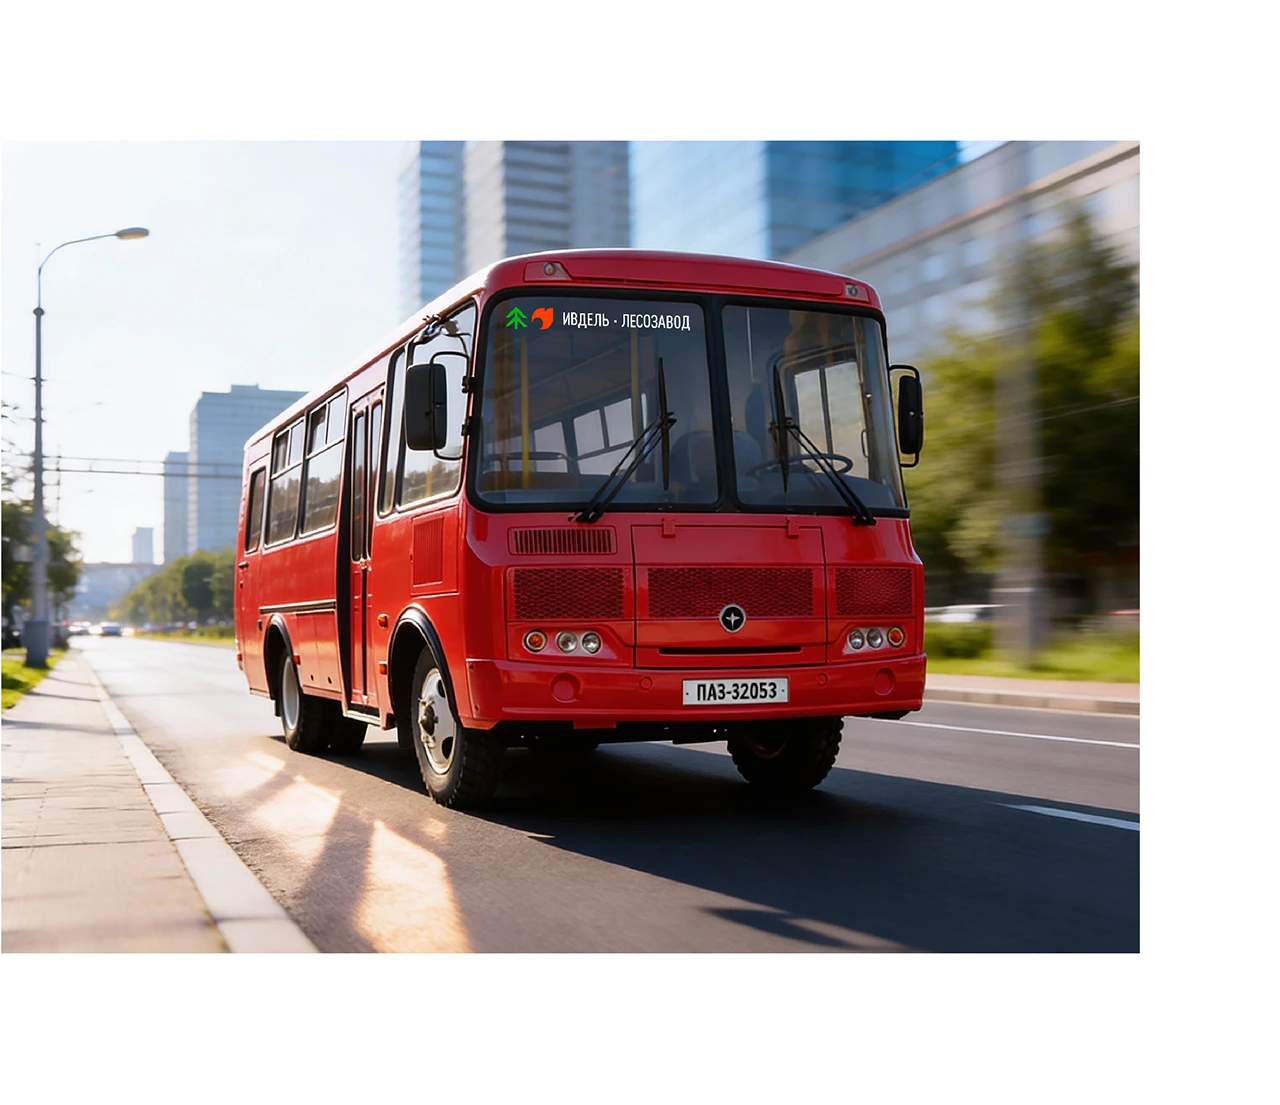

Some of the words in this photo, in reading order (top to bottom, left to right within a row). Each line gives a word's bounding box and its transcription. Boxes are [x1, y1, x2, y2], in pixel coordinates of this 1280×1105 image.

[562, 311, 610, 329] ИВДЕЛЬ
[621, 313, 691, 331] ЛЕСОЗАВОД
[697, 682, 777, 701] ПАЗ-32053
